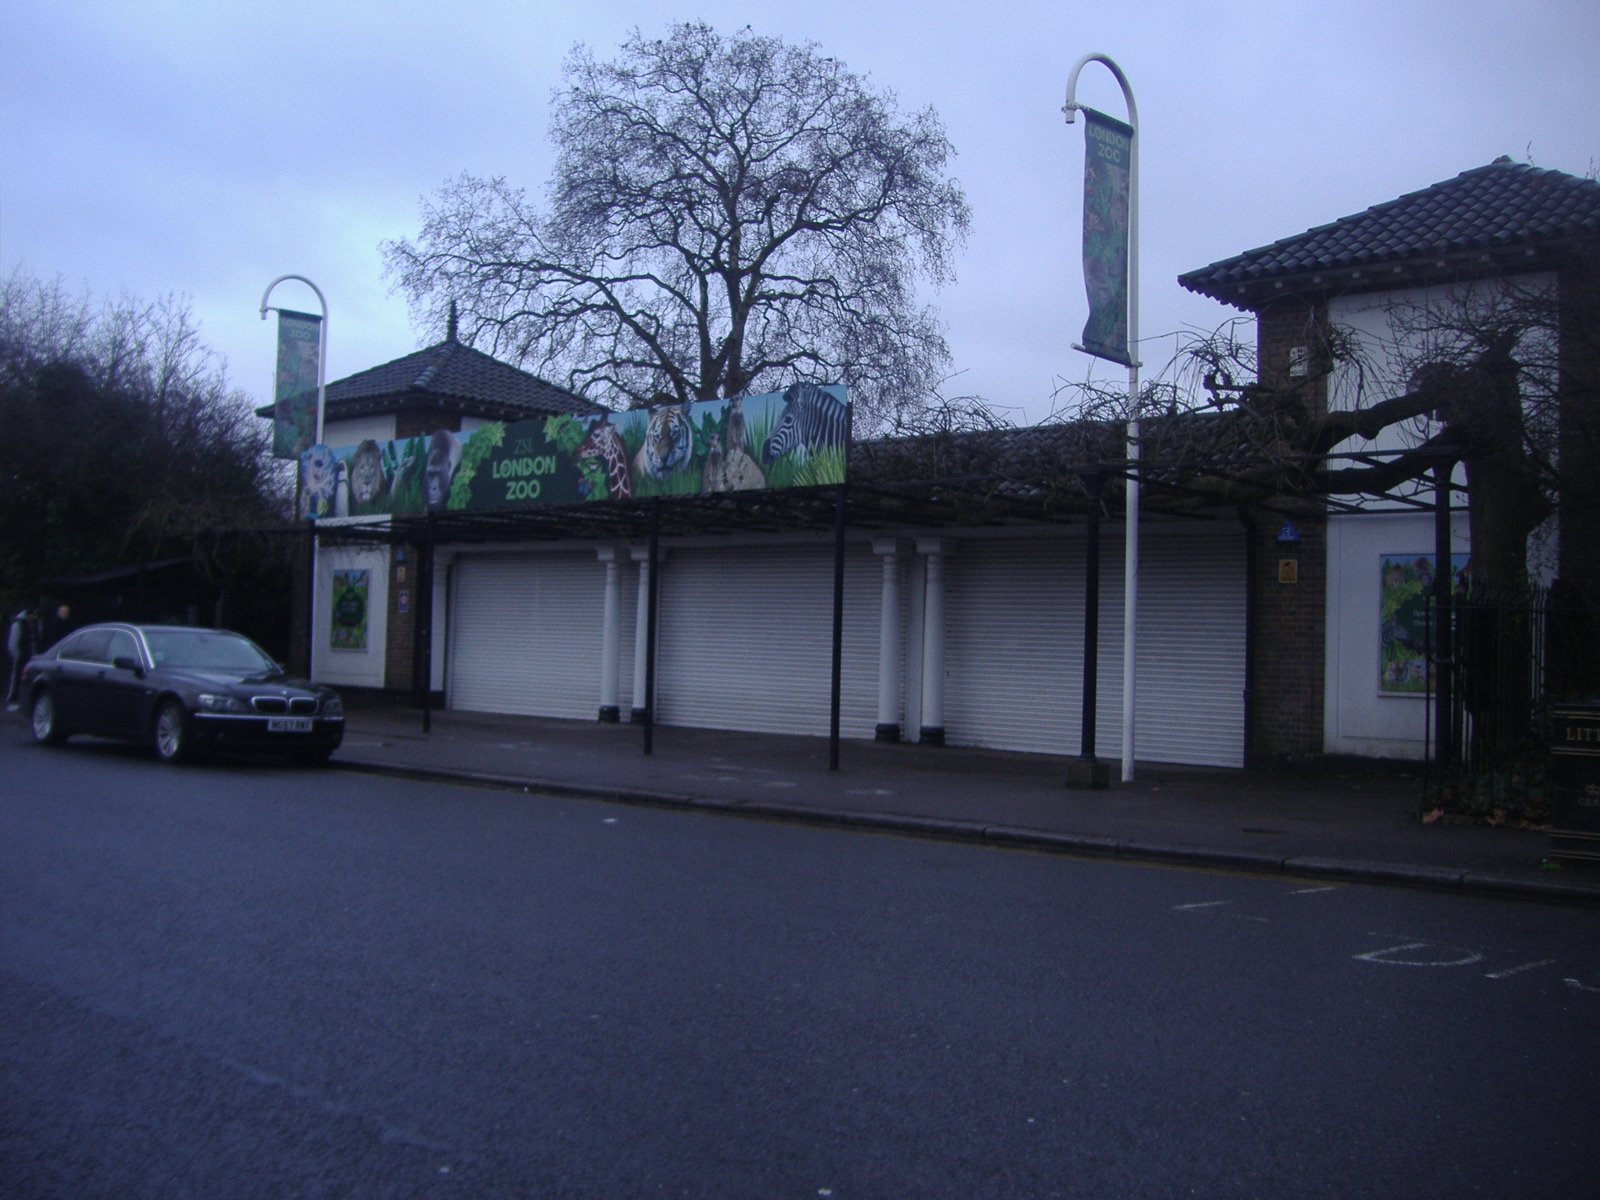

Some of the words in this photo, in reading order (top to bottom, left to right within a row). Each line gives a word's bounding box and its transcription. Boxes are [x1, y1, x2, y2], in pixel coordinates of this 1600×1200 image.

[1089, 123, 1129, 152] LONDON
[1098, 143, 1121, 163] ZOO
[514, 438, 532, 455] ZSL
[492, 455, 556, 479] LONDON
[505, 479, 541, 501] ZOO
